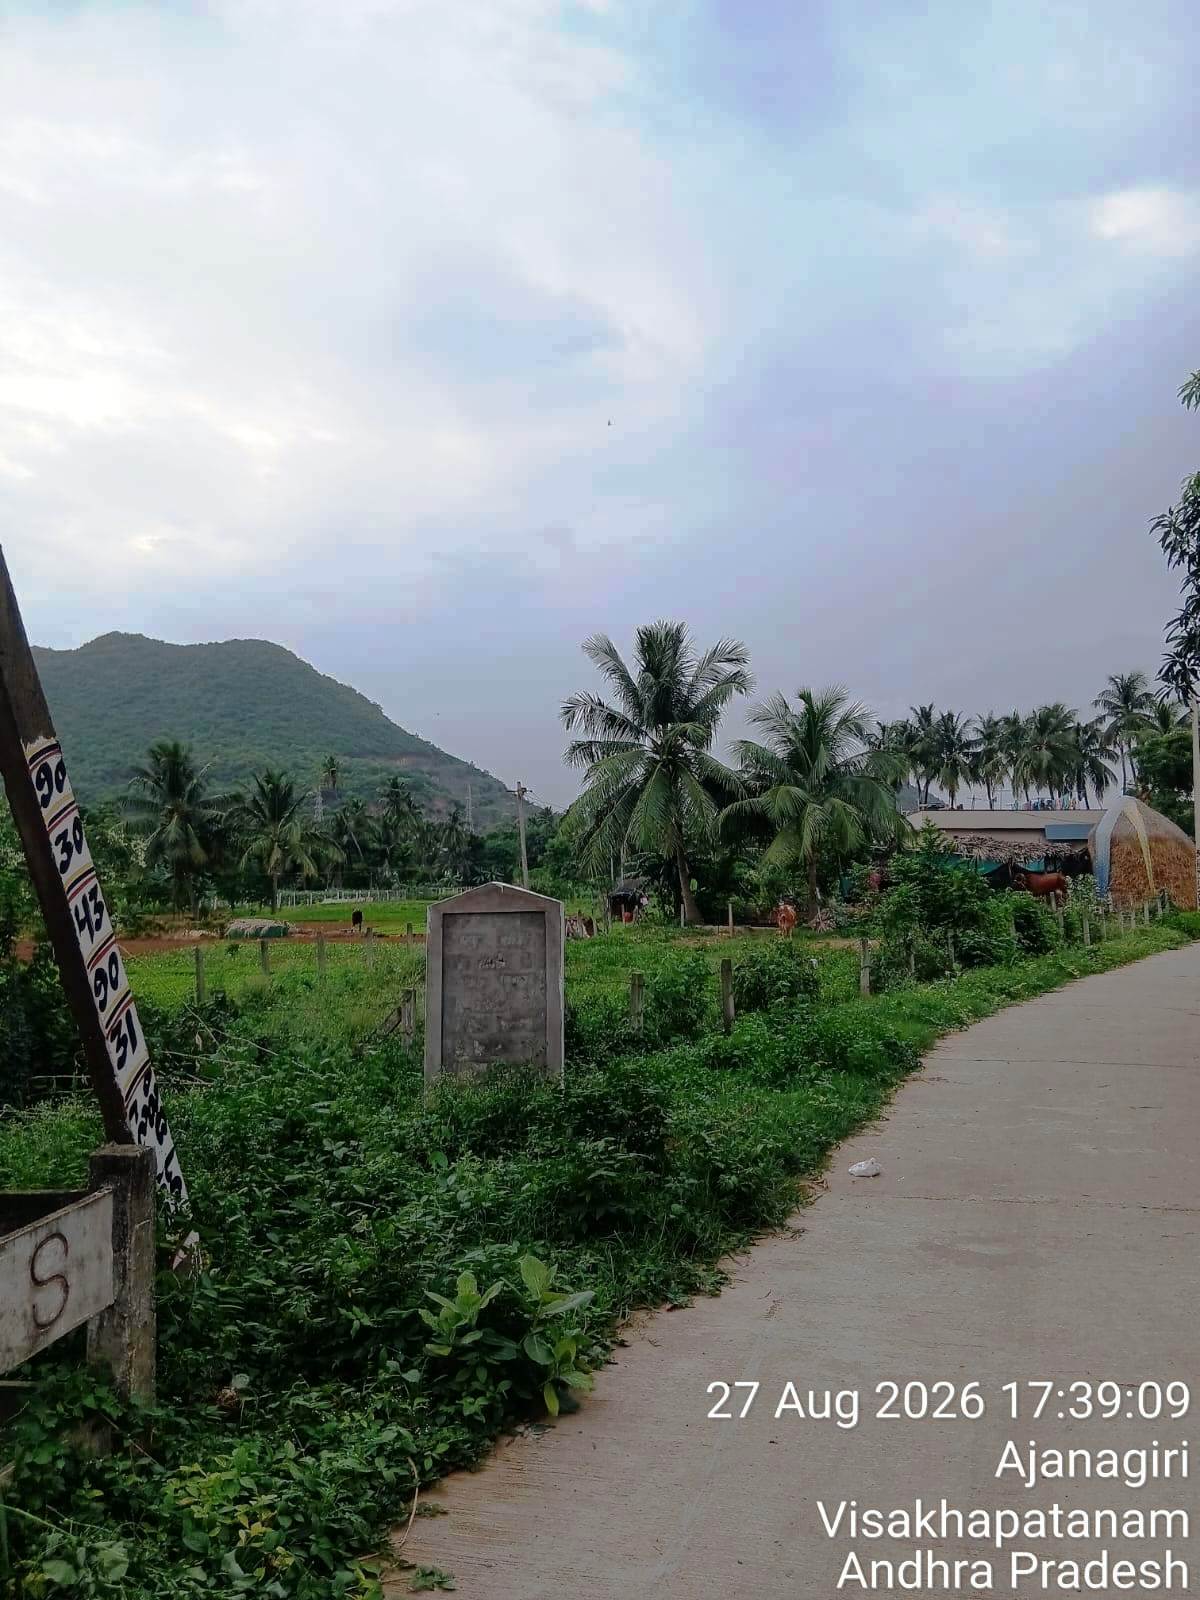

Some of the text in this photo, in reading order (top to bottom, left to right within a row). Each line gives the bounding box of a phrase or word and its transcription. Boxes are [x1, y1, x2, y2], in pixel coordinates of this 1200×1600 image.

[34, 758, 67, 809] 90
[54, 816, 85, 875] 30
[74, 883, 105, 945] 43
[93, 951, 120, 1013] 90
